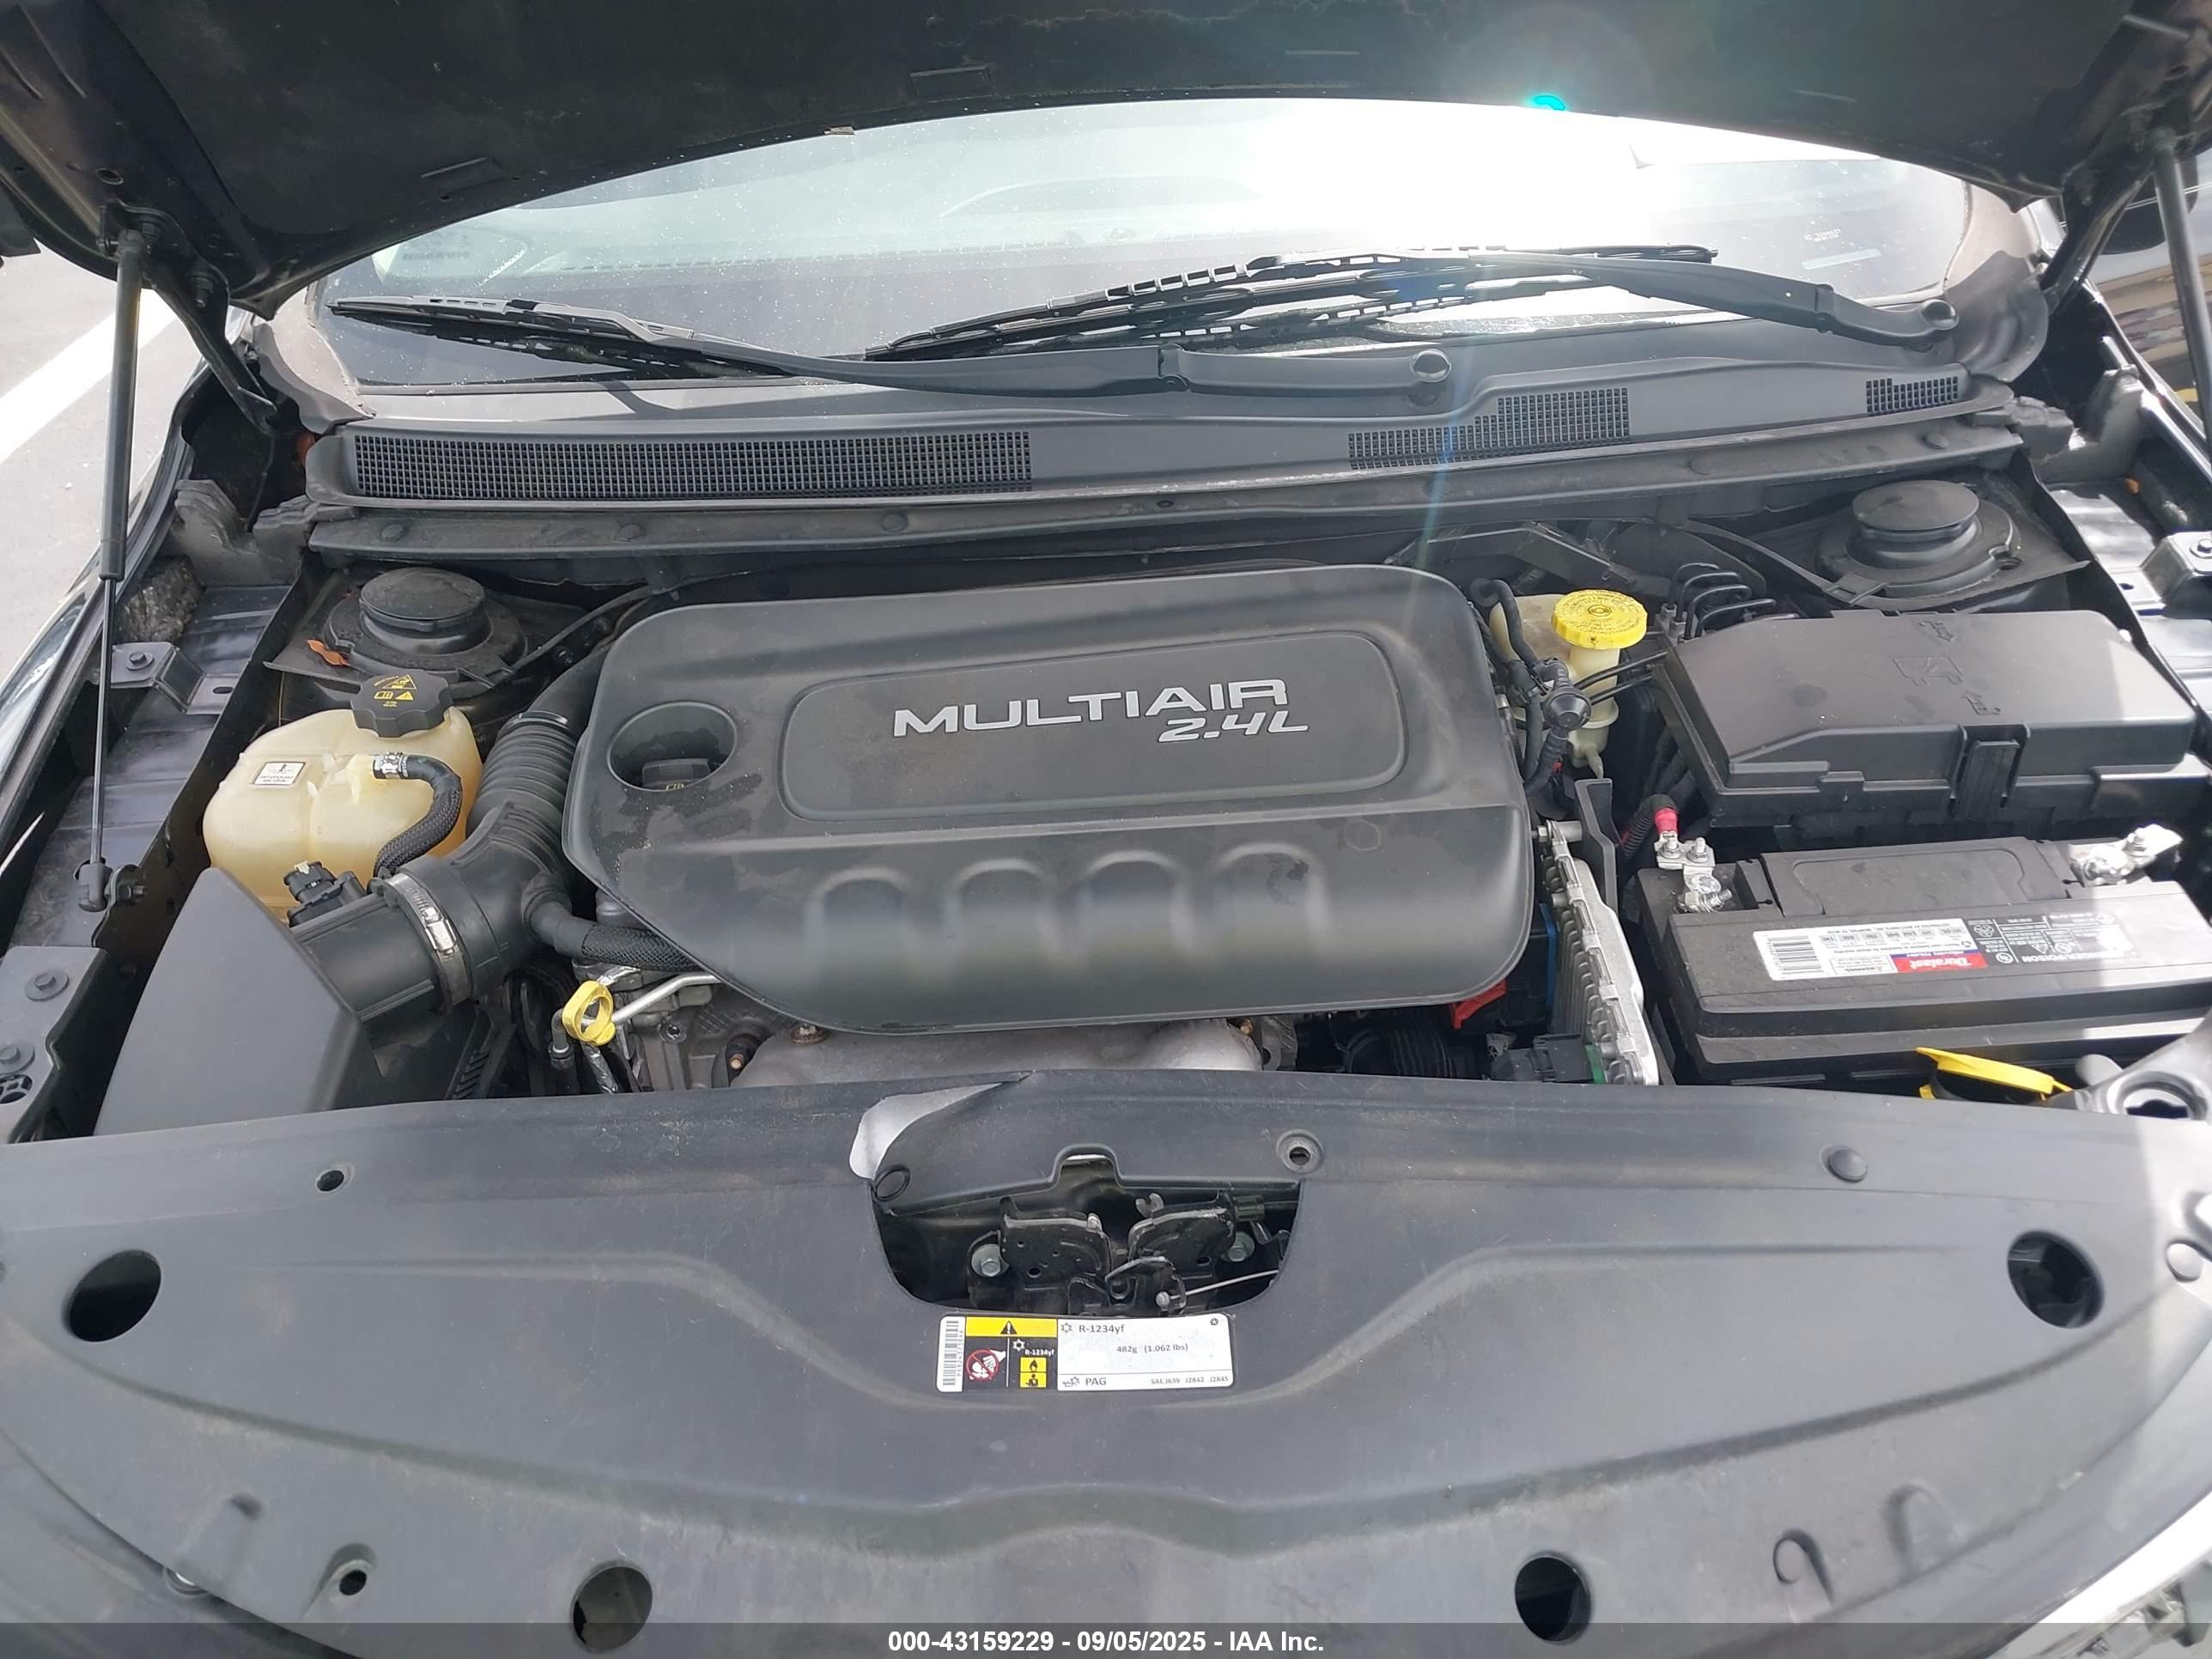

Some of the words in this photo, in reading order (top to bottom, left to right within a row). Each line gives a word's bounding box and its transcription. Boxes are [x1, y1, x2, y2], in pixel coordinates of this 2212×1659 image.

[893, 679, 1287, 737] MULTIAIR
[1158, 710, 1309, 742] 2.4L
[1910, 957, 1972, 969] Duralast
[1079, 1324, 1125, 1334] R-1234yf
[1144, 1344, 1170, 1353] (1.062
[1173, 1343, 1188, 1352] lbs)
[1085, 1377, 1107, 1386] PAG
